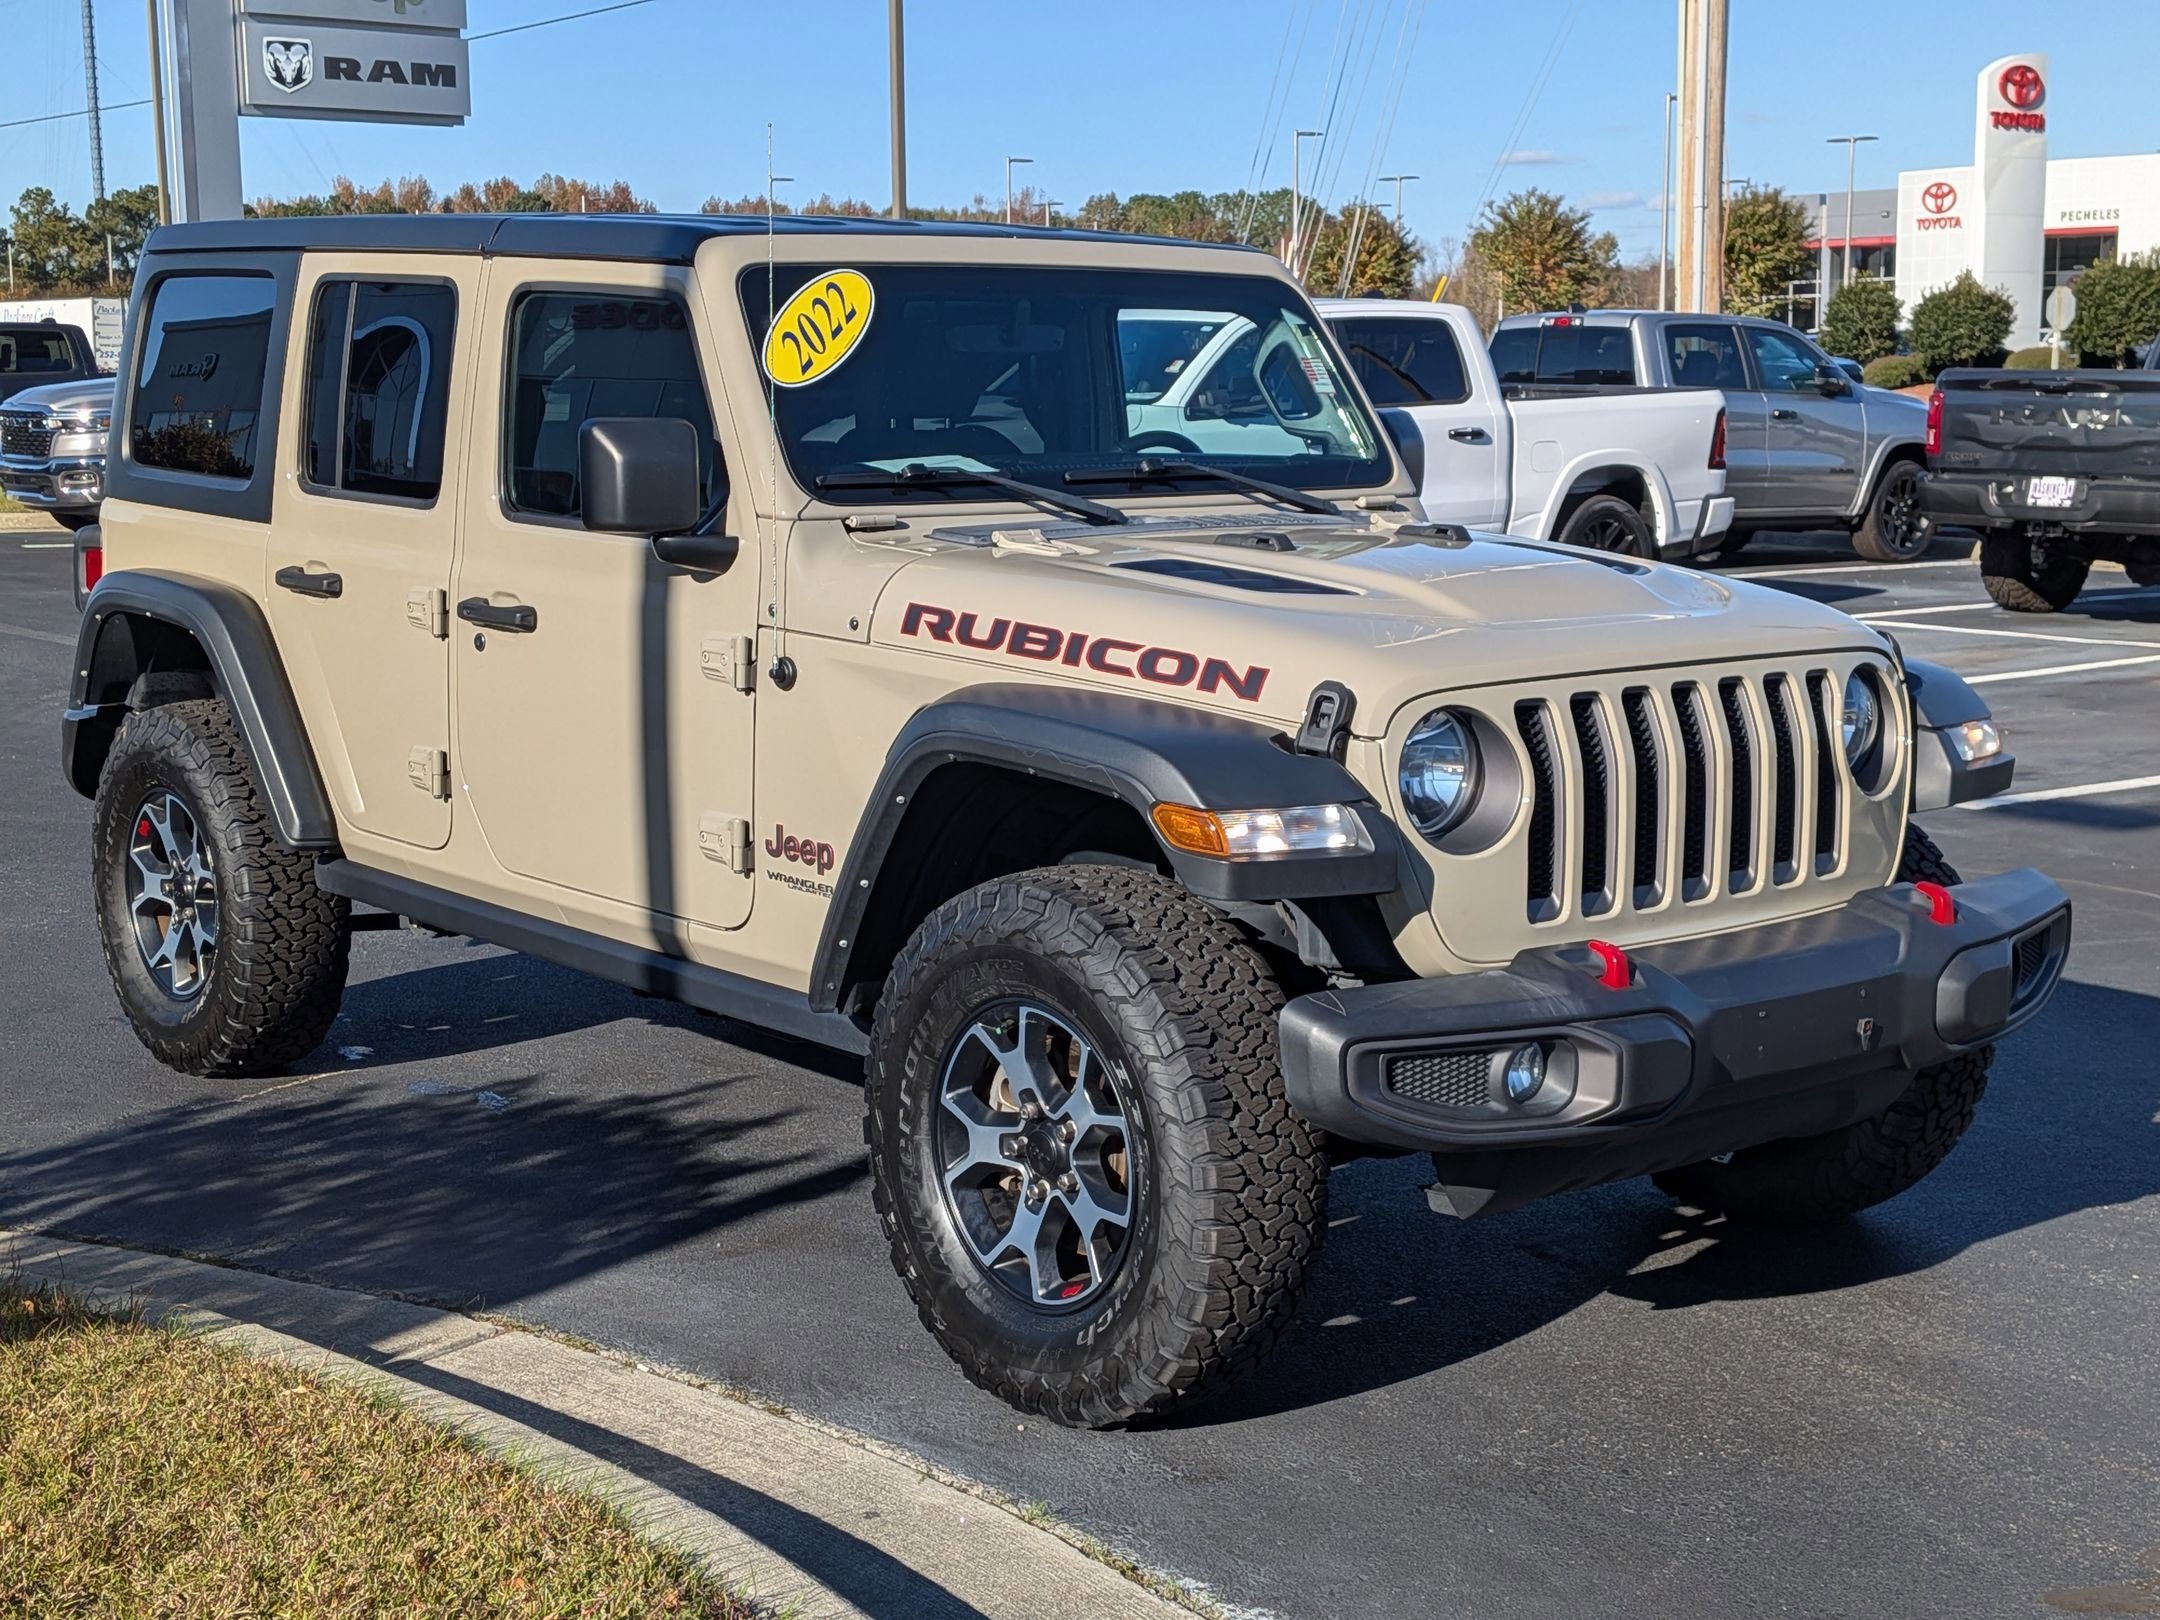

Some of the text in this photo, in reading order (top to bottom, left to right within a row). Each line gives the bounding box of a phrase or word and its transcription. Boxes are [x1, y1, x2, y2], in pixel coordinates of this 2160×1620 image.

[323, 55, 457, 88] RAM
[1989, 111, 2046, 132] TOYOTA
[1916, 216, 1963, 231] TOYOTA
[2060, 208, 2120, 222] PECHELES
[781, 281, 857, 376] 2022
[899, 601, 1271, 703] RUBICON
[764, 823, 835, 876] Jeep
[766, 868, 834, 895] WRANGLER
